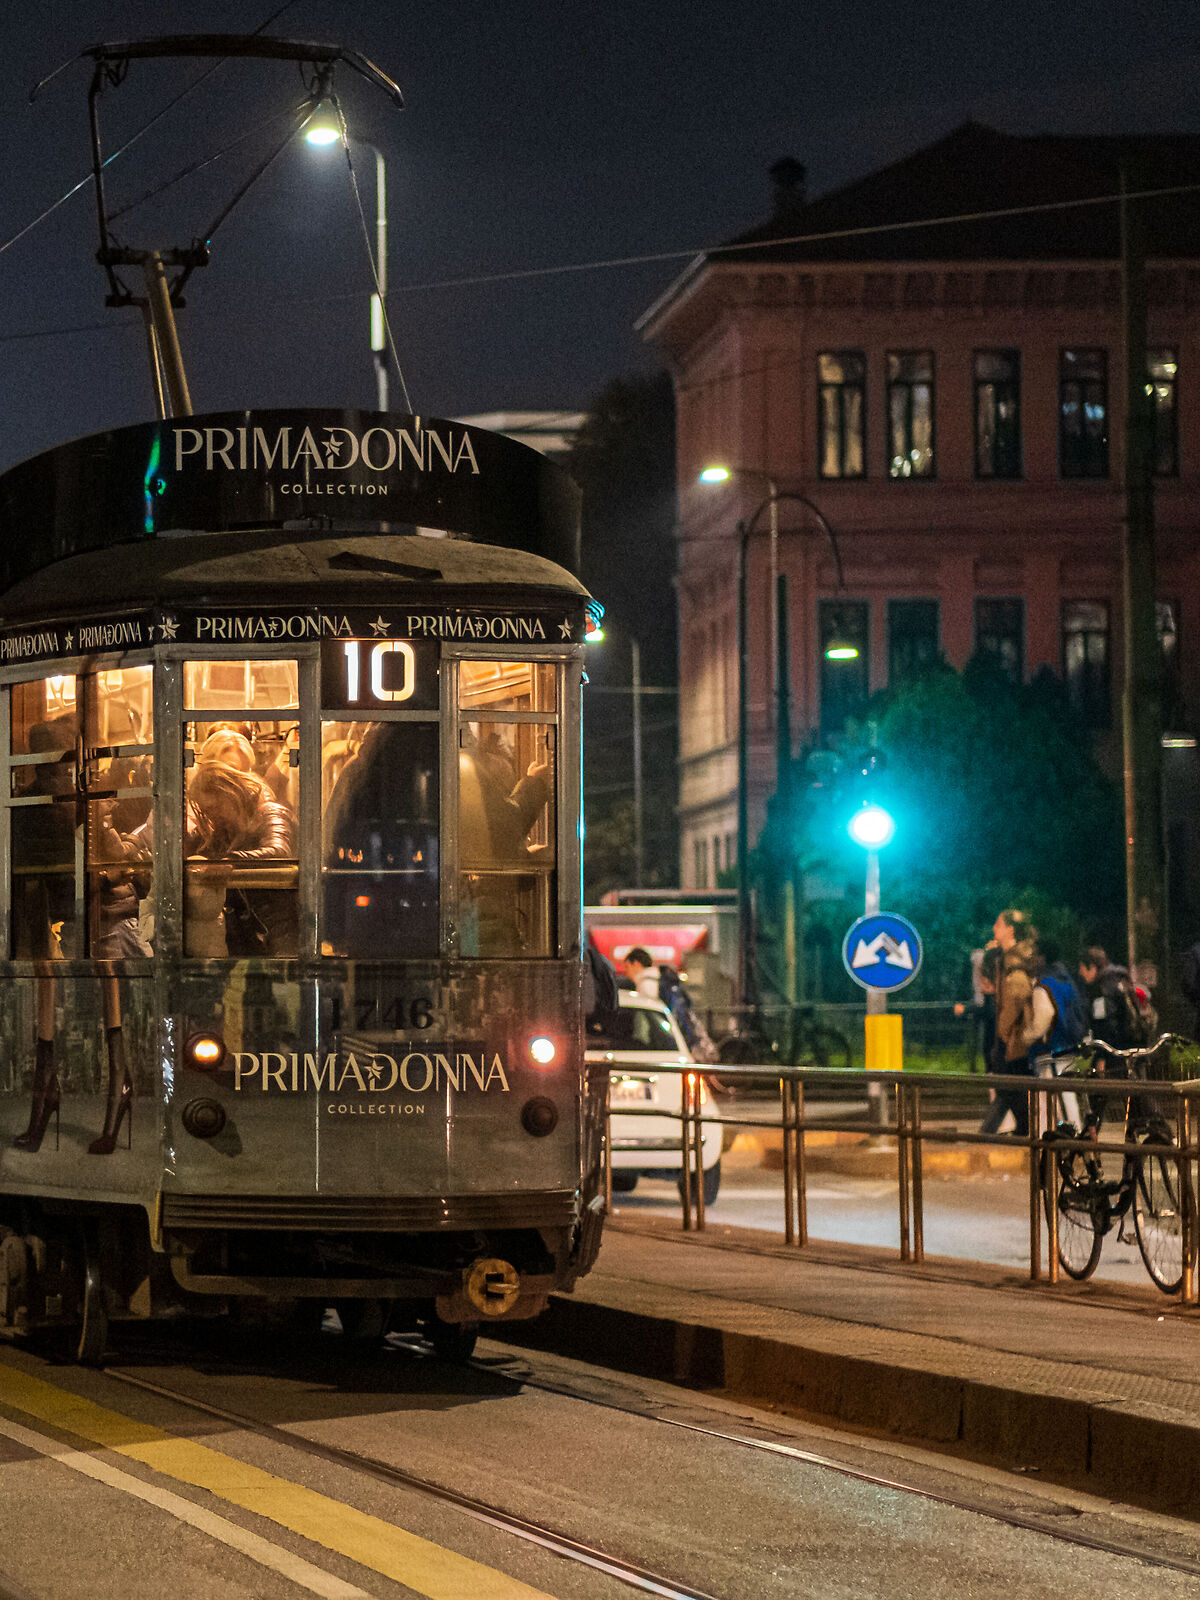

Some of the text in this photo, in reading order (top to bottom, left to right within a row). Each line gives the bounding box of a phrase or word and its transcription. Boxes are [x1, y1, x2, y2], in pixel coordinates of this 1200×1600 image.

[172, 426, 480, 475] PRIMADONNA
[280, 484, 389, 496] COLLECTION
[0, 621, 142, 660] PRIMADONNA PRIMADONNA
[195, 615, 546, 639] PRIMADONNA PRIMADONNA
[344, 641, 415, 702] 10
[231, 1052, 510, 1092] PRIMADONNA
[327, 1104, 426, 1115] COLLECTION
